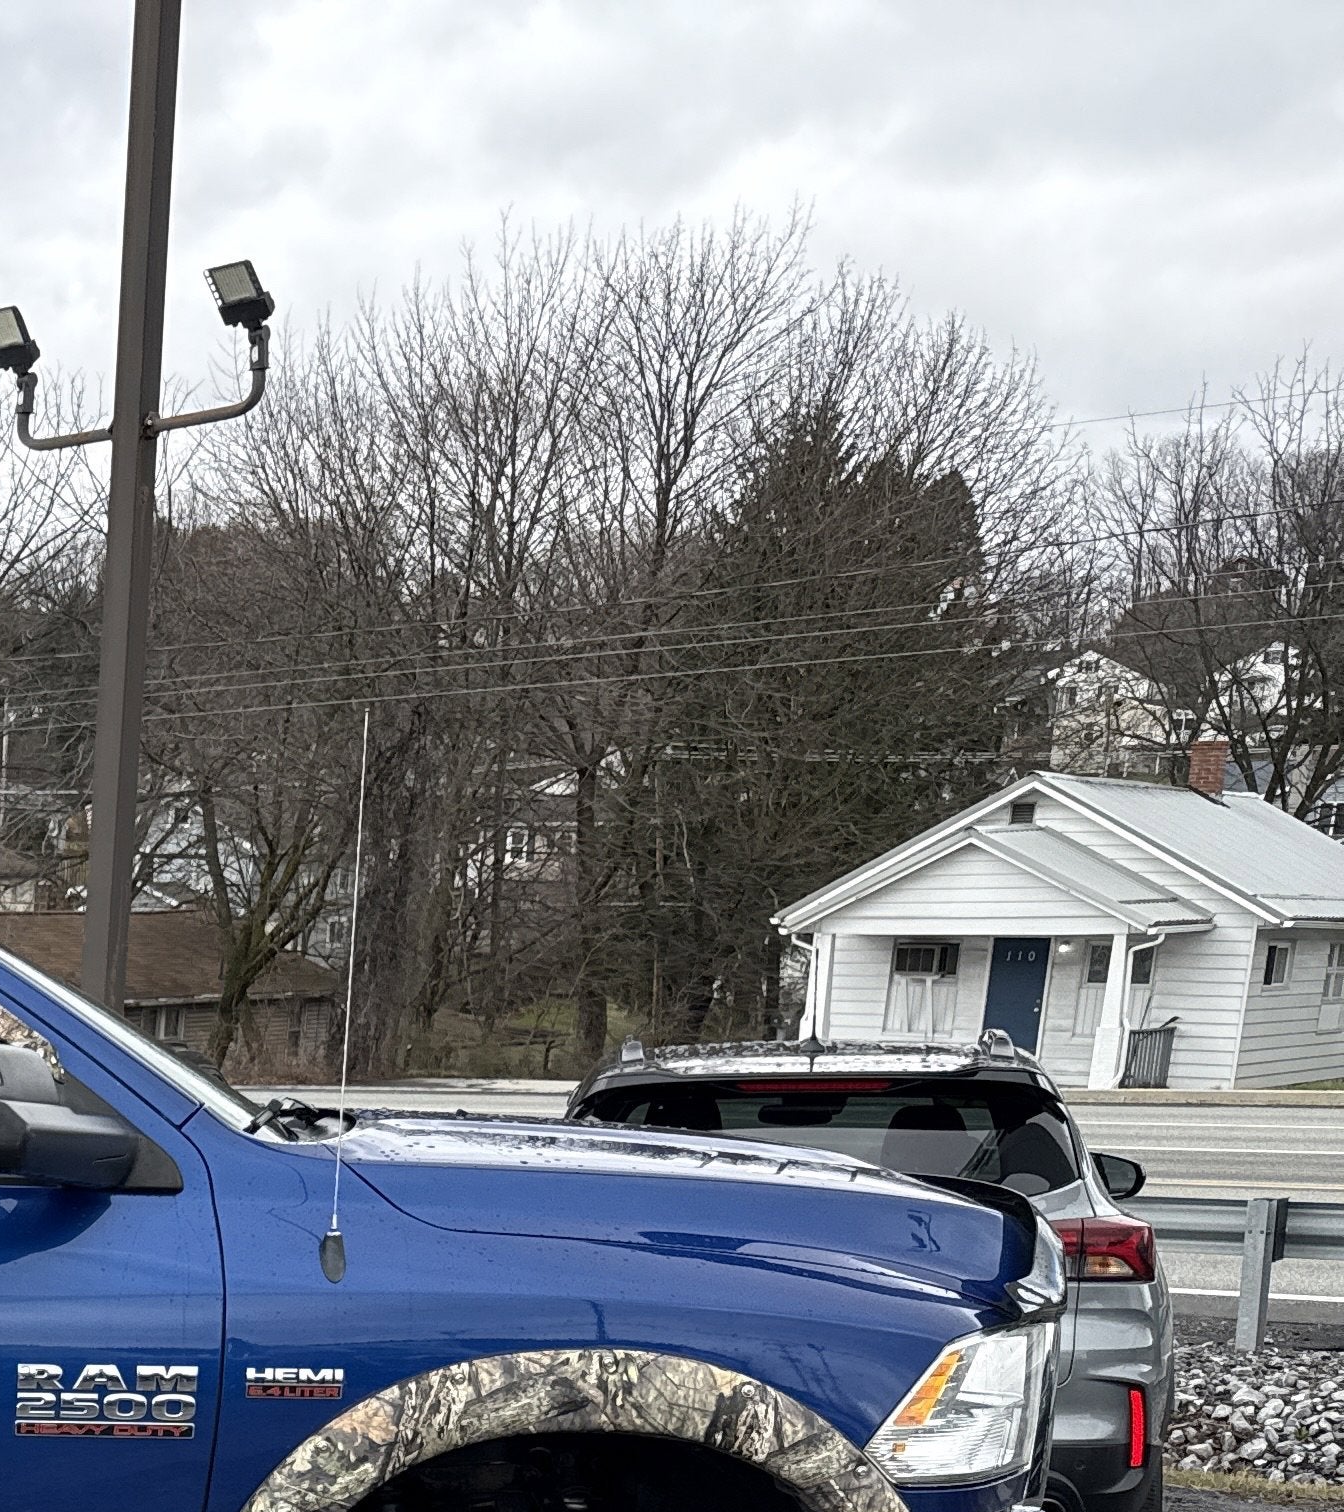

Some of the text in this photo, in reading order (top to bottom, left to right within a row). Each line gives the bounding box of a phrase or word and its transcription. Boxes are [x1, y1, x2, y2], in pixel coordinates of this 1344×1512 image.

[1006, 950, 1036, 961] 110
[17, 1363, 199, 1392] RAM
[246, 1367, 344, 1383] HEMI
[248, 1386, 339, 1397] 6.4 LITER
[15, 1392, 197, 1421] 2500
[20, 1423, 190, 1437] HEAVY DUTY
